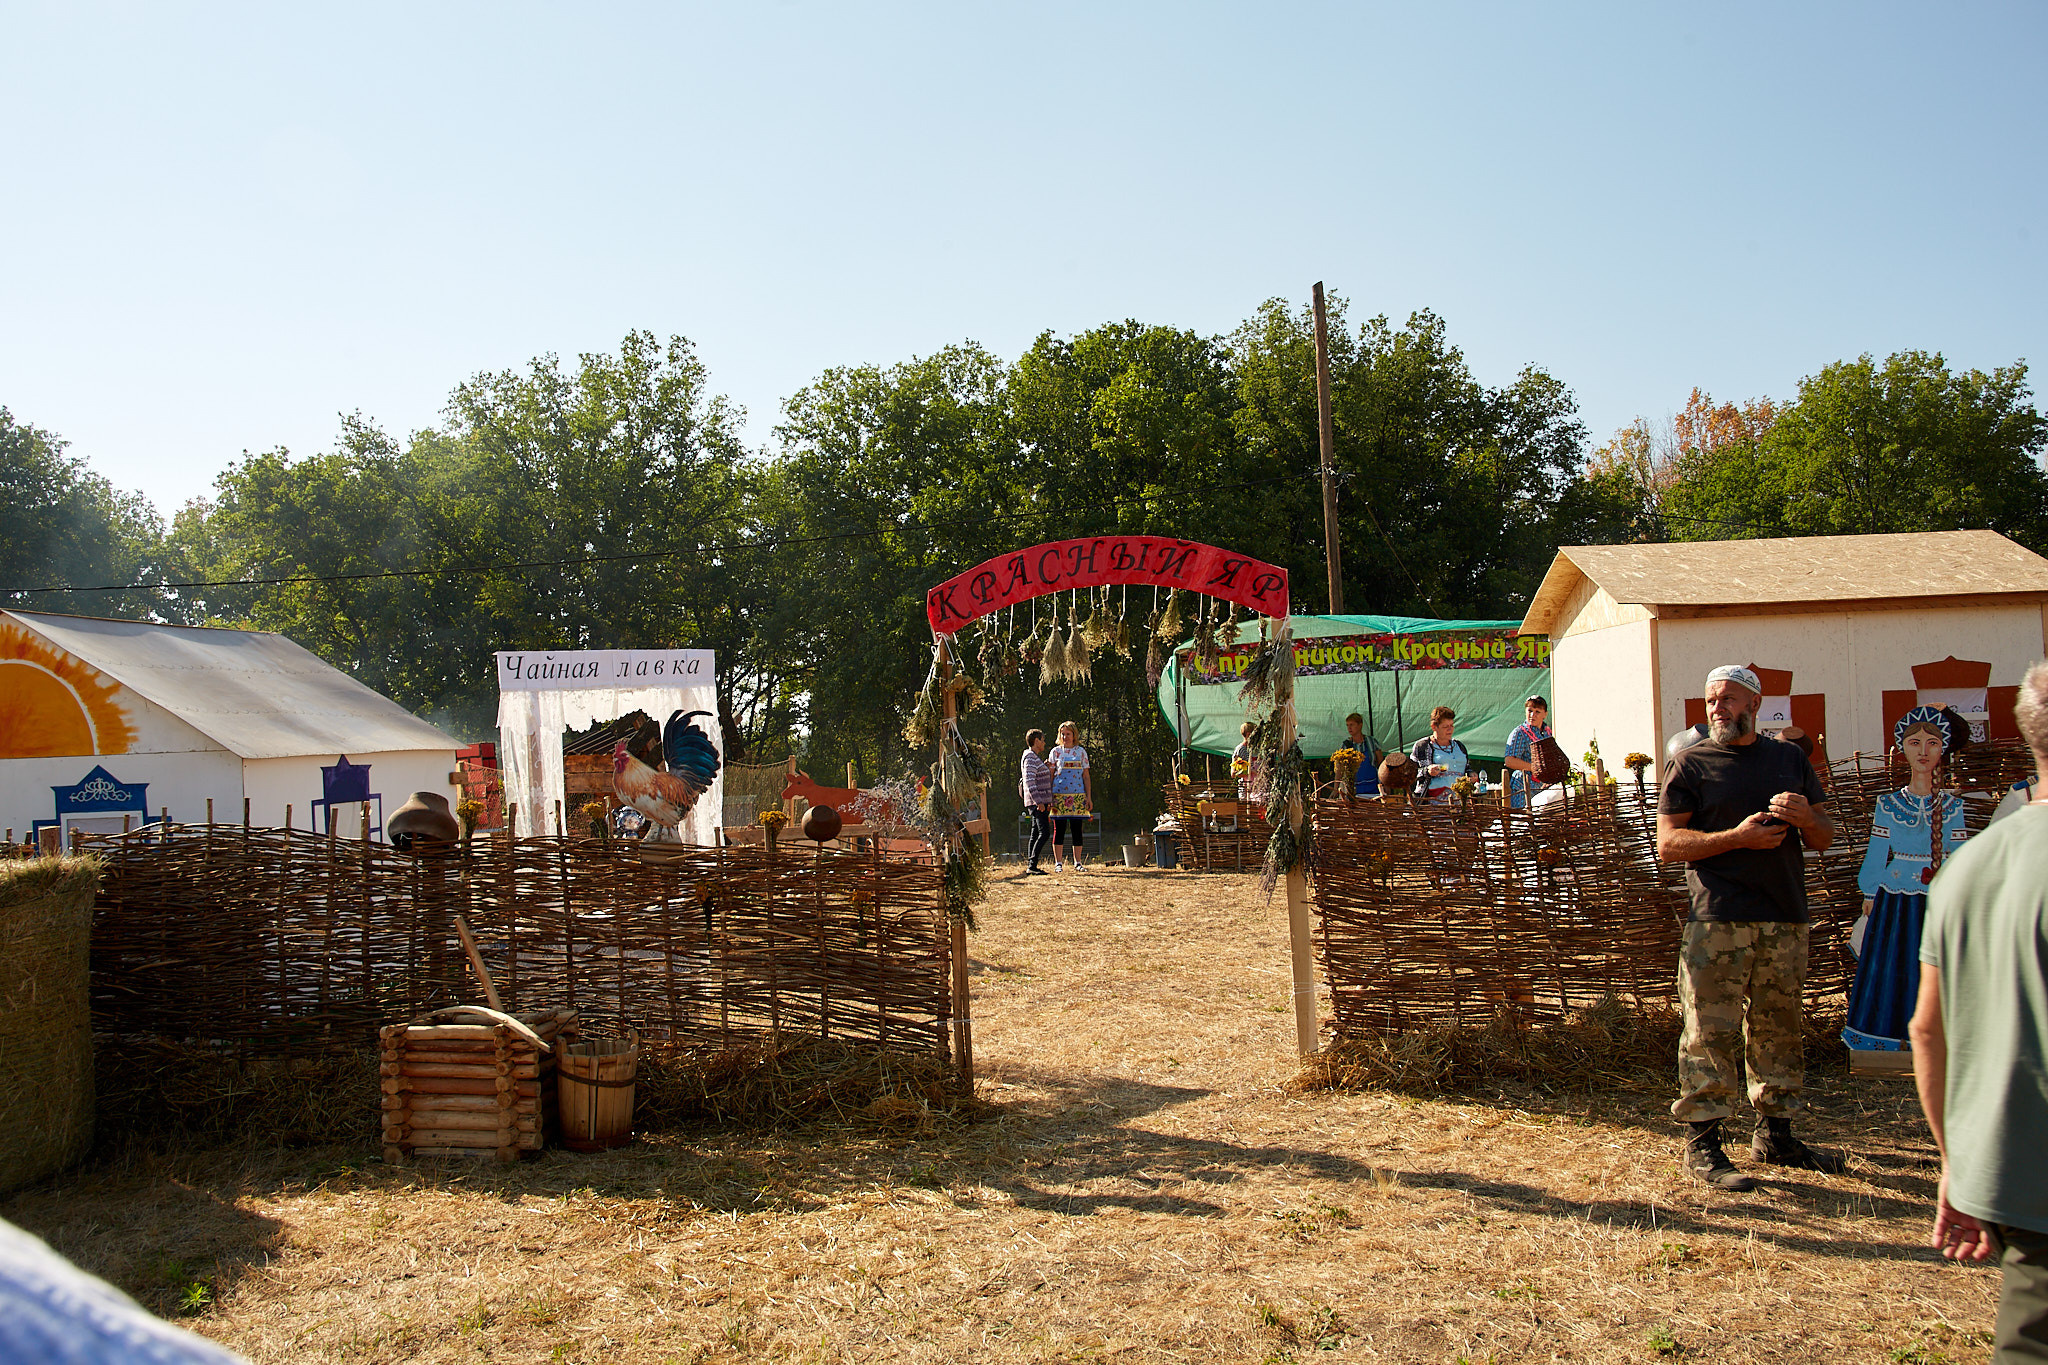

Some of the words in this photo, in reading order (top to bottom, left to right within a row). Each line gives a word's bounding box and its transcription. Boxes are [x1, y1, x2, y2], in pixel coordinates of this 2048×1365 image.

[929, 540, 1198, 623] КРАСНЫЙ
[1207, 558, 1285, 602] ЯР
[505, 655, 600, 680] Чайная
[616, 658, 701, 678] лавка
[1219, 645, 1382, 677] прником,
[1393, 638, 1506, 665] Красный
[1517, 636, 1550, 663] Яр
